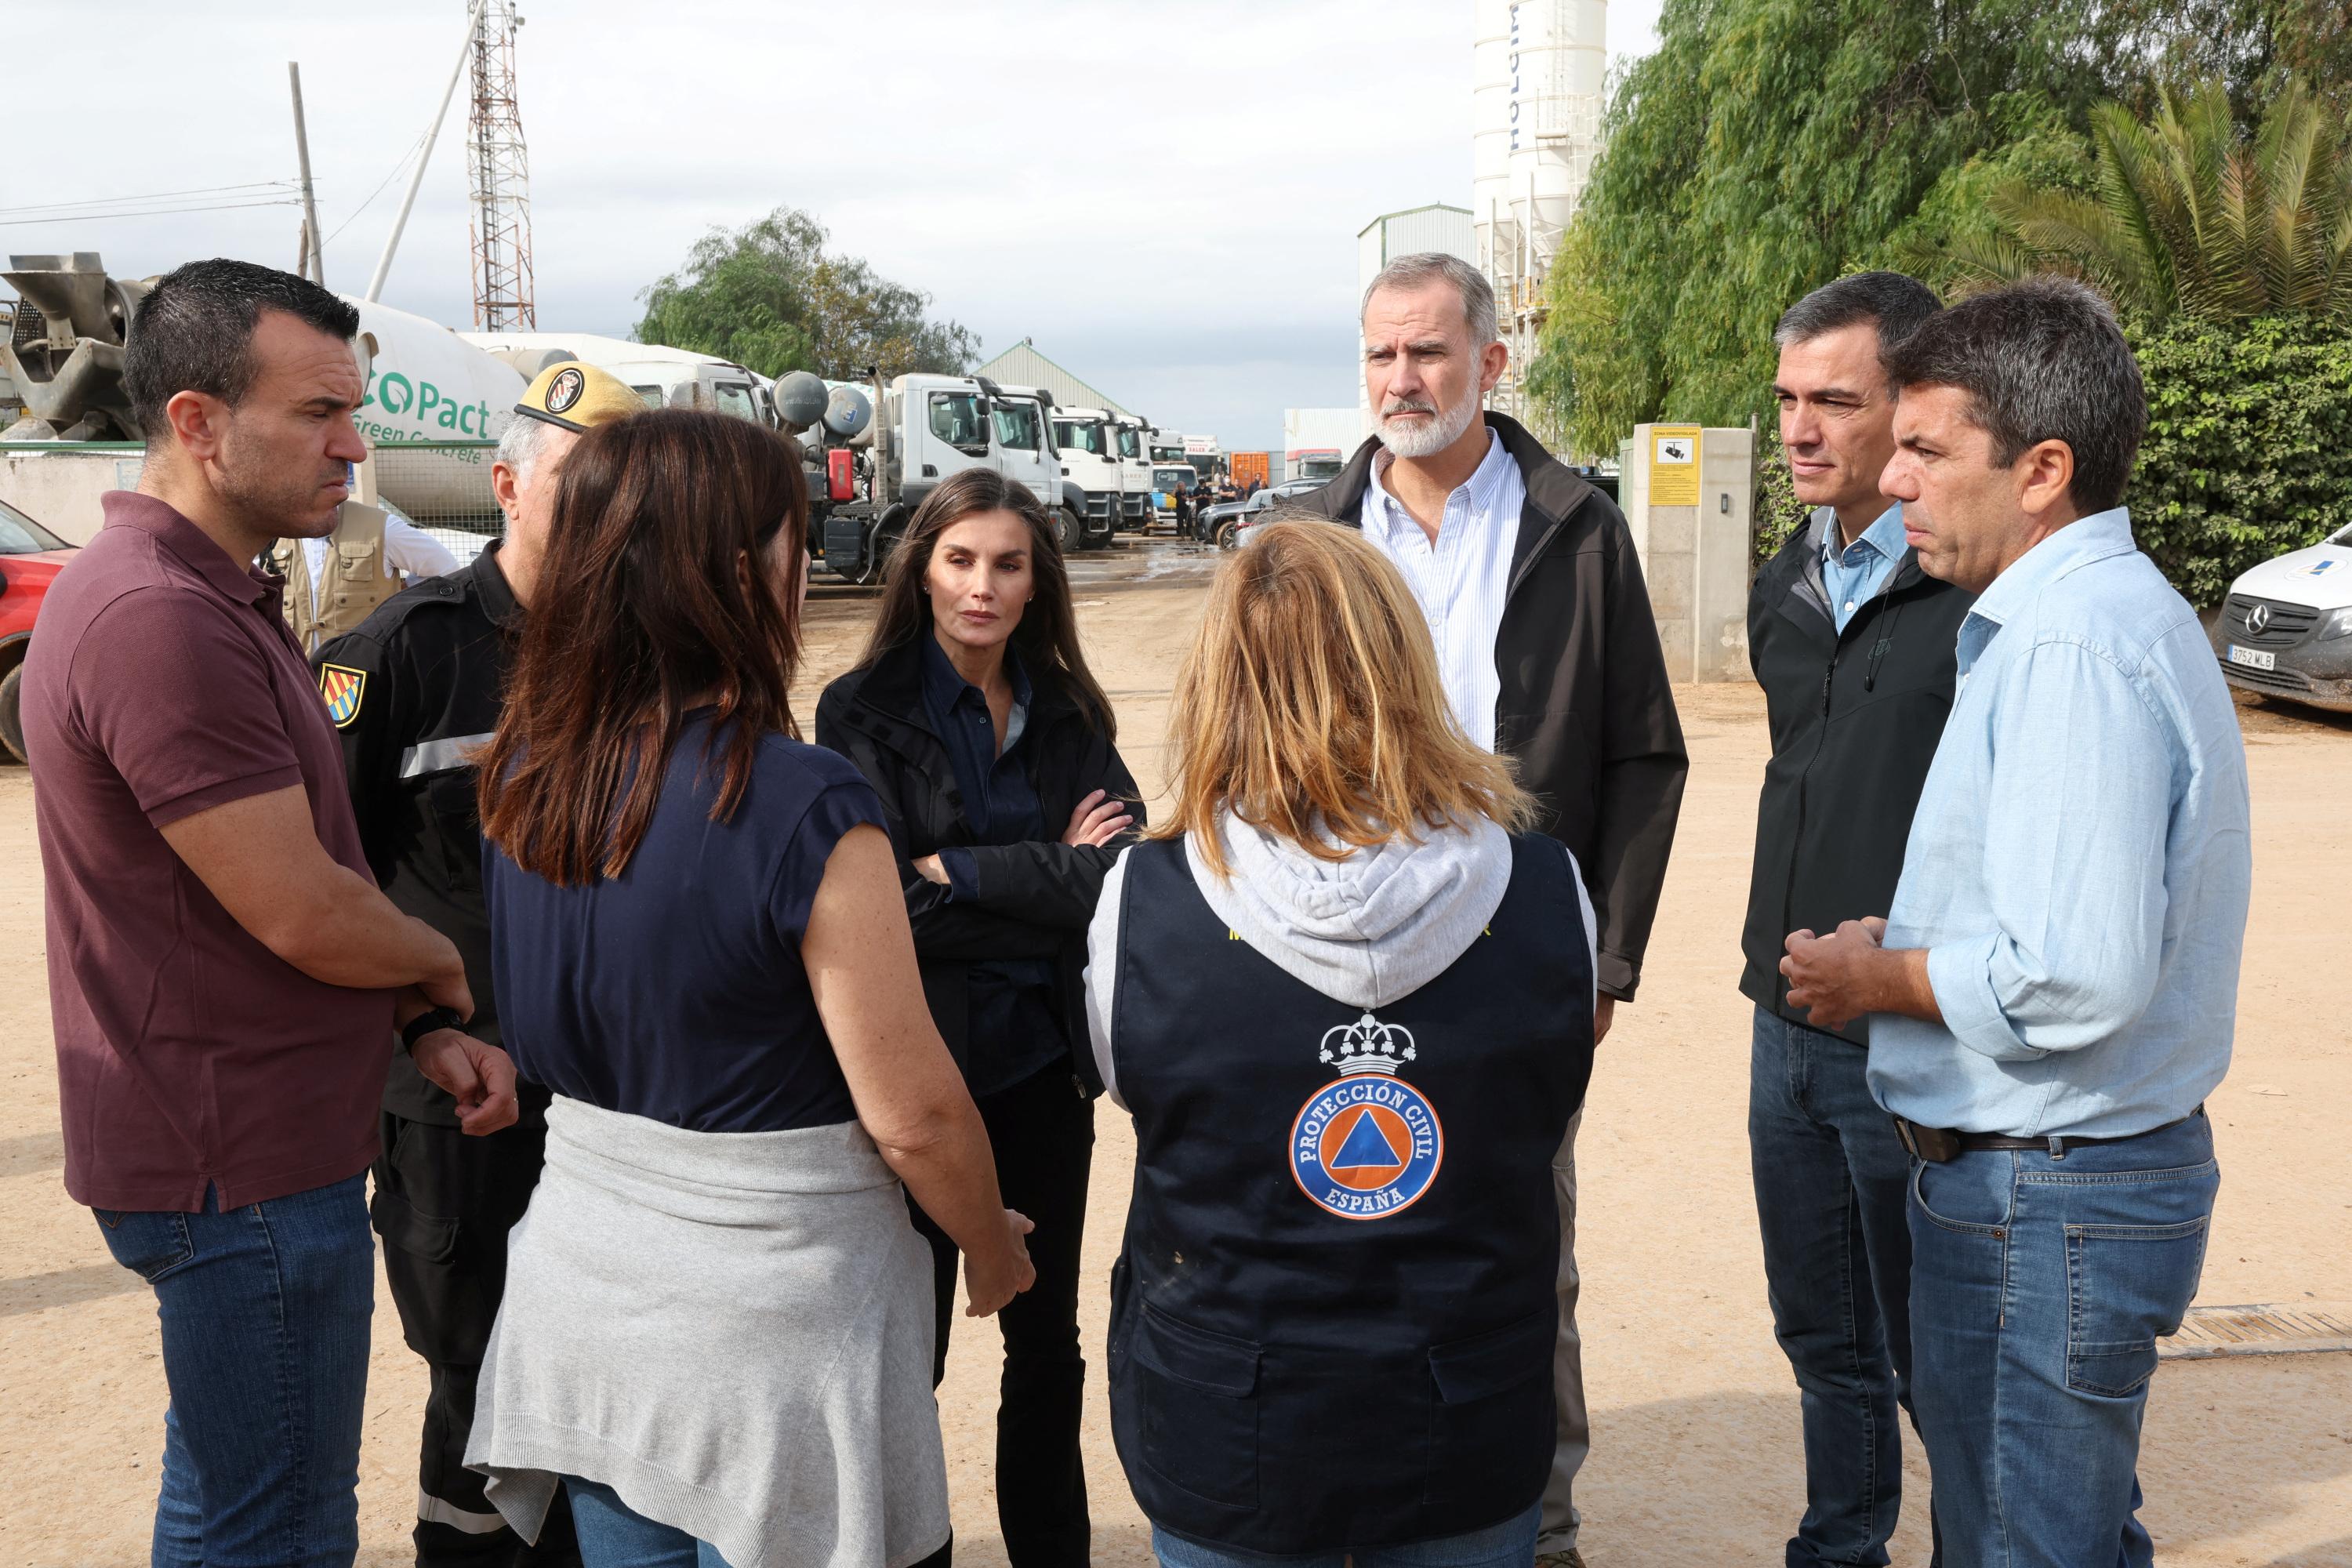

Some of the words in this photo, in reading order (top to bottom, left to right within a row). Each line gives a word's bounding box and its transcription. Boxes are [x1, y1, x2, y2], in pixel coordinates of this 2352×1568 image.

[1510, 5, 1519, 151] HOLCIM
[2234, 649, 2253, 664] 3752
[2254, 652, 2272, 668] MLB
[1300, 1082, 1408, 1163] PROTECCIÓN
[1405, 1105, 1433, 1160] CIVIL
[1324, 1188, 1406, 1212] ESPAÑA
